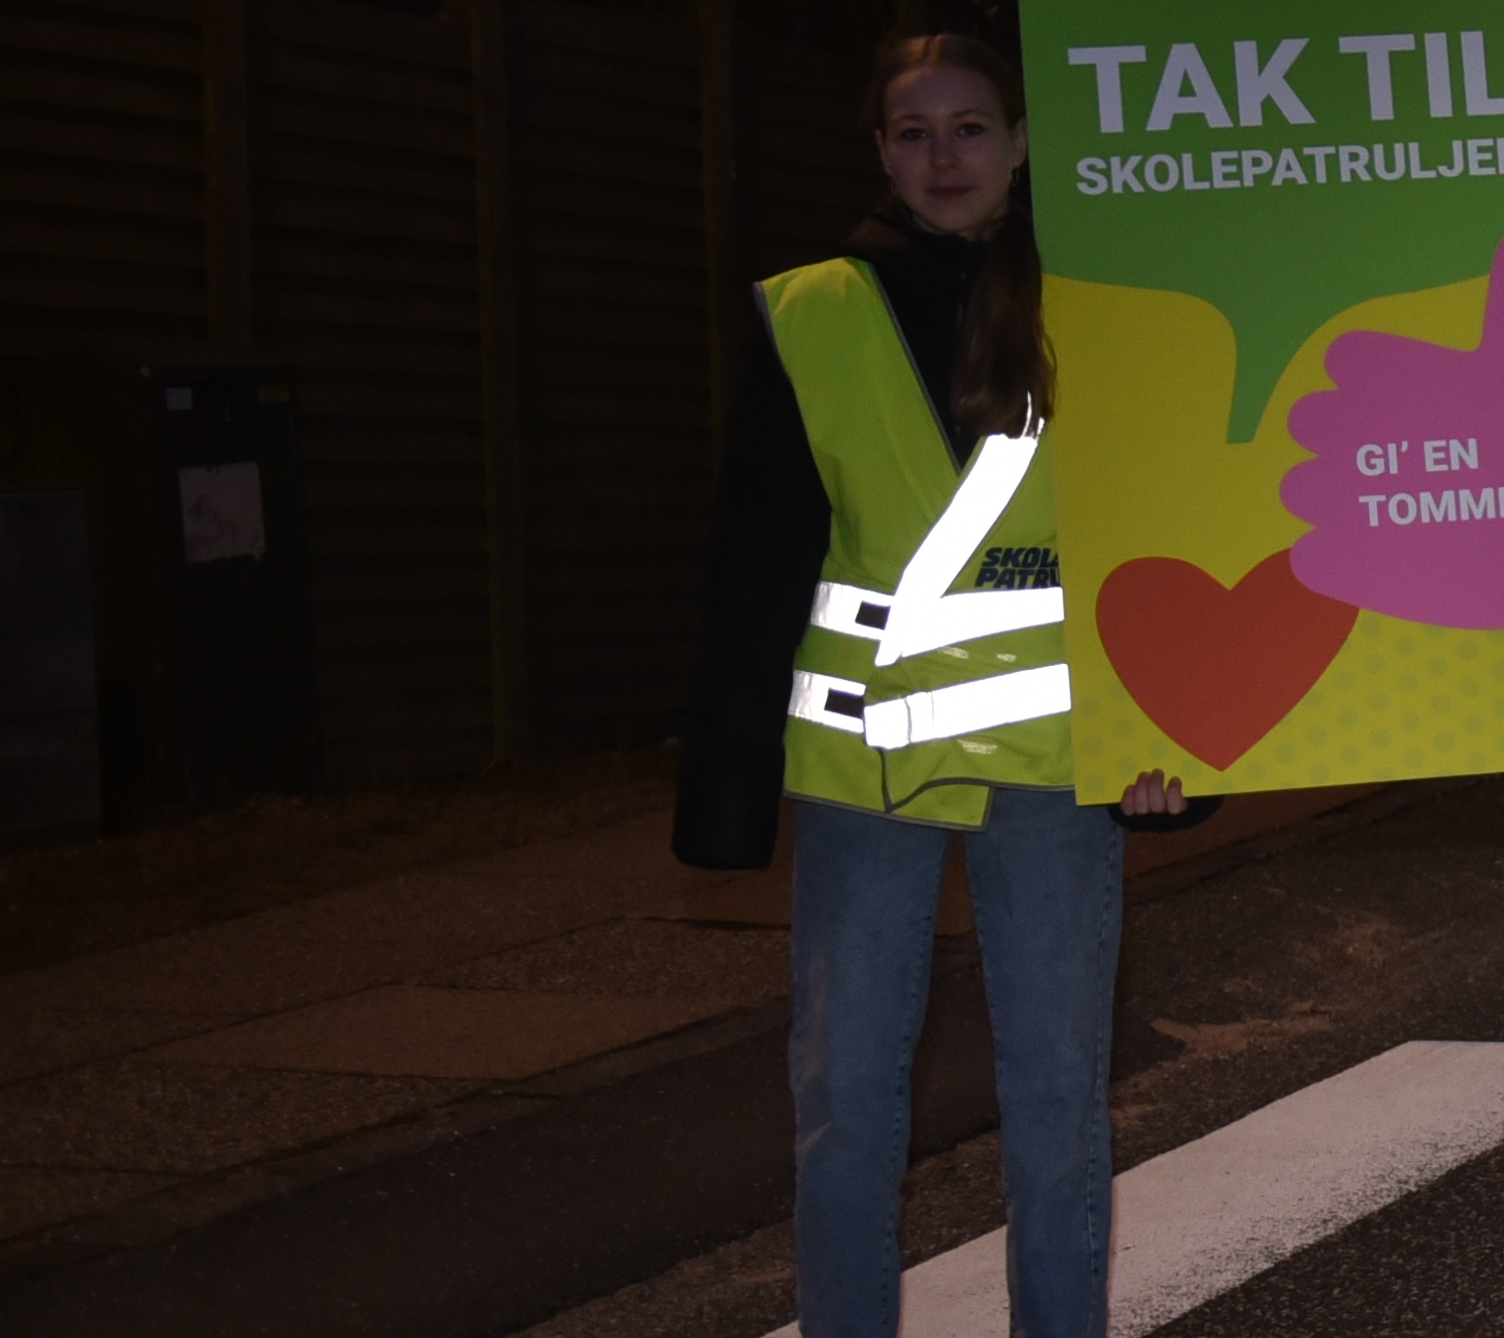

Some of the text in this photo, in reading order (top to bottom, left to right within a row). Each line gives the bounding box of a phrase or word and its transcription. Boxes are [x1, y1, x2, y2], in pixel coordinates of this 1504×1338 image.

[1067, 37, 1317, 133] TAK
[1423, 437, 1480, 472] EN
[982, 546, 1059, 569] SKOL
[974, 567, 1061, 590] PATRU
